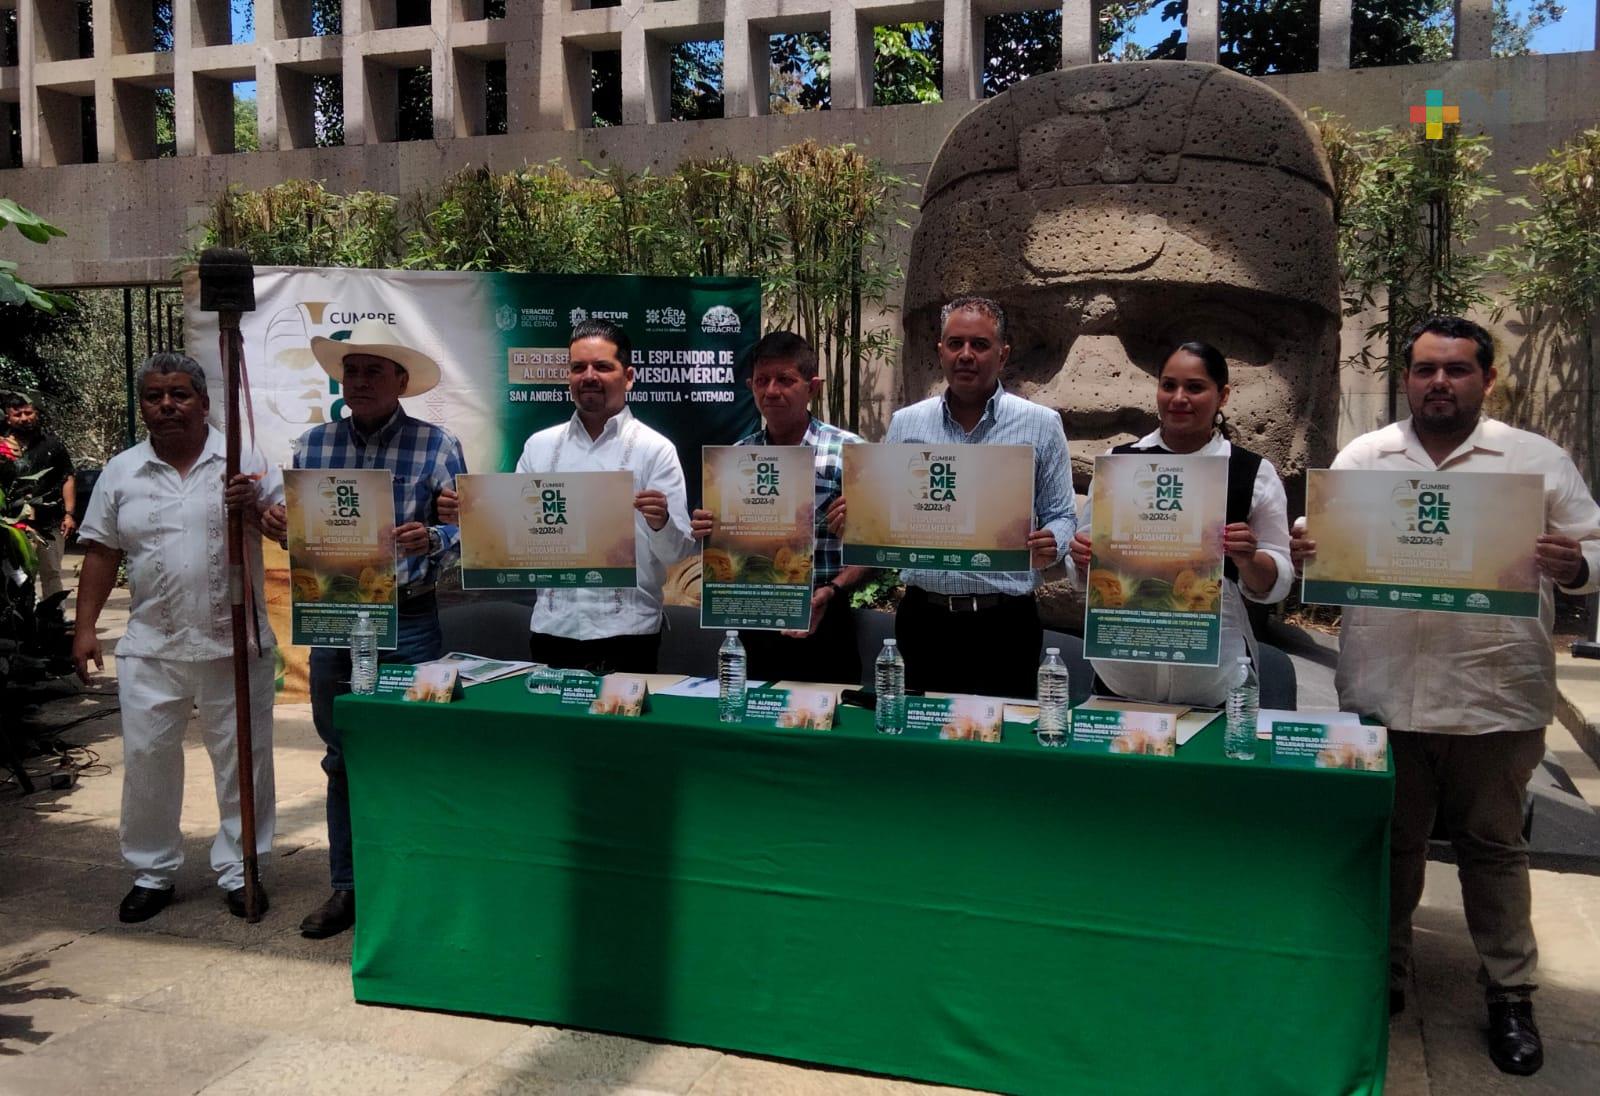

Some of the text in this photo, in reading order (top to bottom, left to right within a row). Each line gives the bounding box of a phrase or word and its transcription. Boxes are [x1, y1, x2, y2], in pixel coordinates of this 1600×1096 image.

[591, 311, 629, 320] SECTUR
[661, 317, 686, 327] CRUZ
[513, 353, 528, 364] DEL
[530, 353, 542, 364] 29
[544, 353, 554, 364] DE
[631, 350, 734, 365] EL ESPLENDOR DE
[523, 368, 534, 379] AL
[547, 368, 558, 379] DE
[632, 364, 735, 384] MESOAMÉRICA
[509, 390, 527, 402] SAN
[529, 388, 563, 402] ANDRÉS
[650, 391, 682, 402] TUXTLA
[690, 391, 735, 402] CATEMACO
[757, 463, 779, 474] OL
[930, 463, 956, 476] OL
[757, 474, 779, 485] ME
[930, 476, 956, 488] ME
[1156, 474, 1184, 486] OL
[336, 485, 359, 496] OL
[542, 490, 566, 501] OL
[757, 485, 779, 496] CA
[930, 489, 957, 502] CA
[1156, 487, 1183, 499] ME
[337, 497, 359, 507] ME
[1418, 492, 1451, 506] OL
[543, 502, 566, 513] ME
[1156, 499, 1183, 511] CA
[338, 507, 360, 518] CA
[1418, 507, 1450, 520] ME
[543, 513, 568, 525] CA
[1418, 520, 1450, 535] CA
